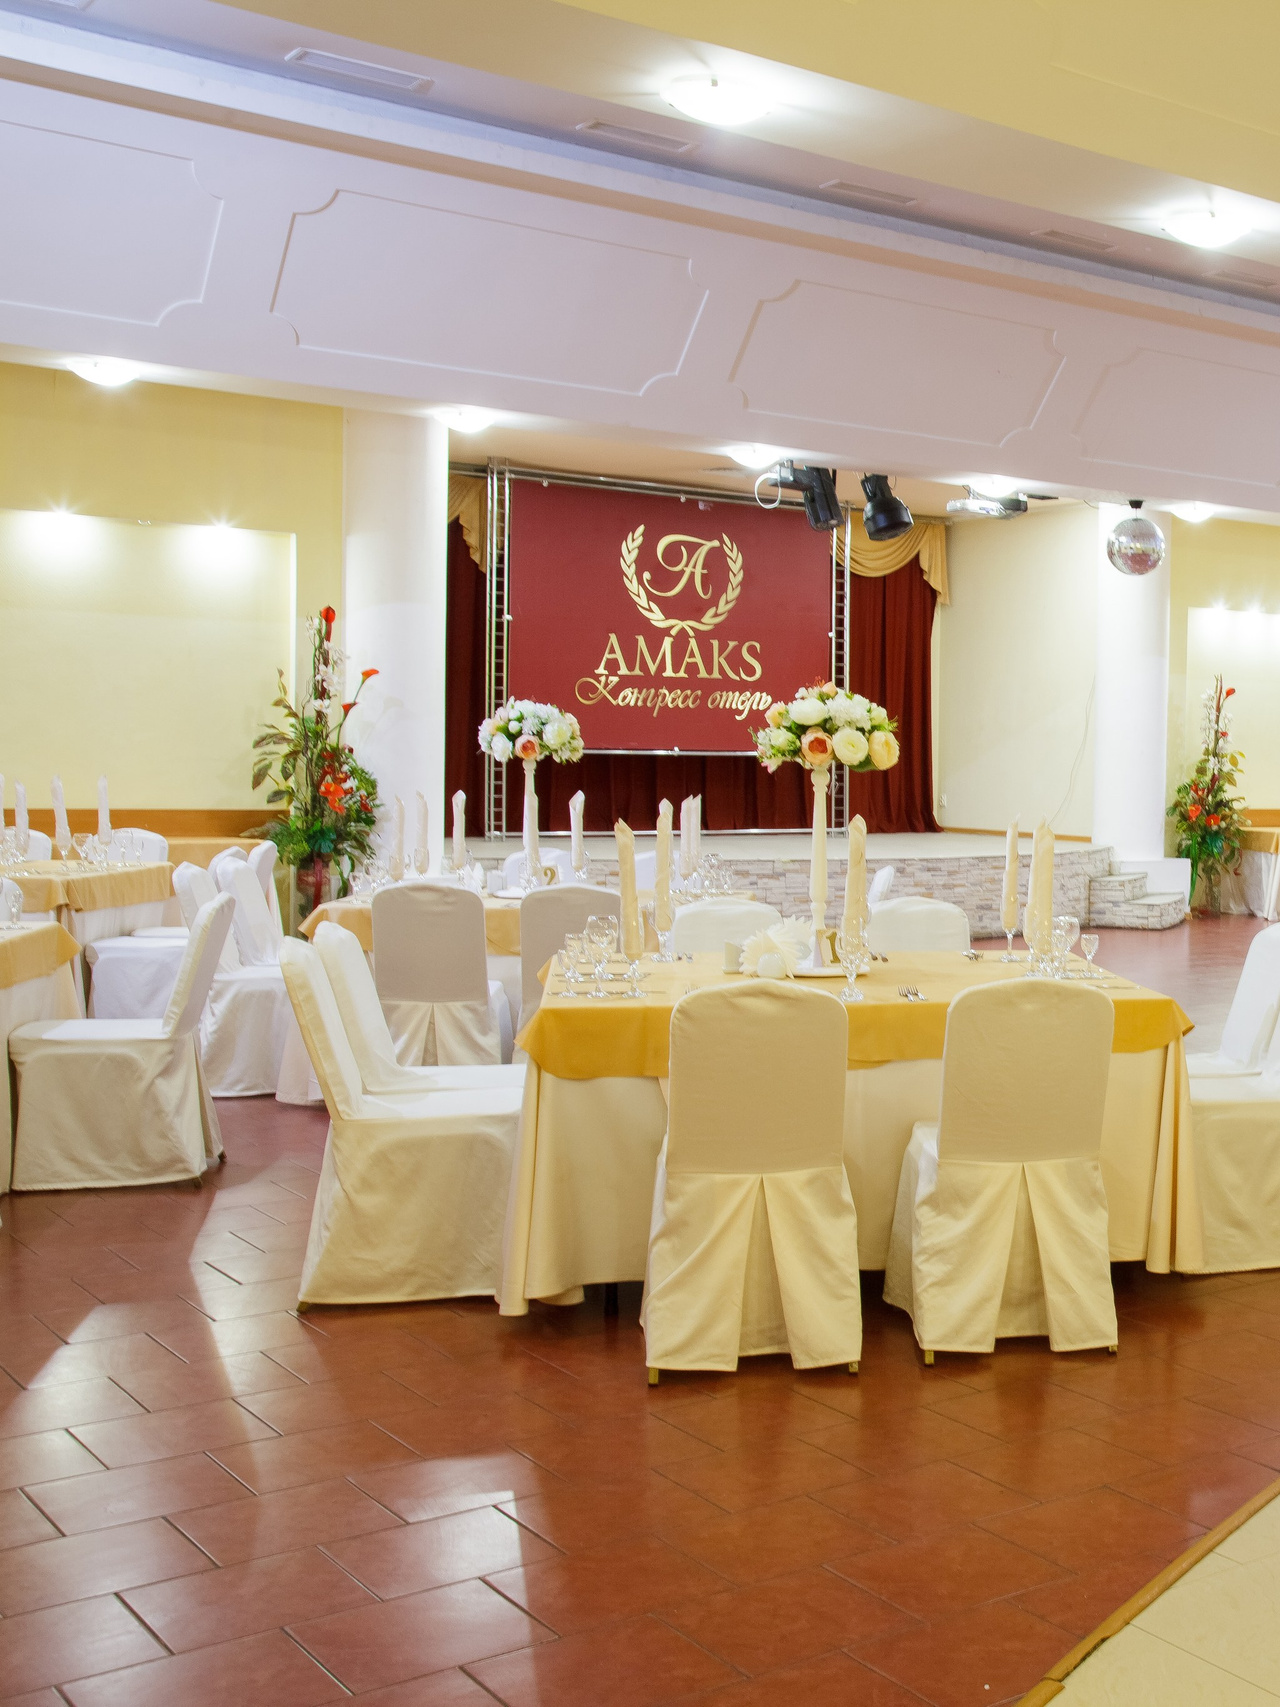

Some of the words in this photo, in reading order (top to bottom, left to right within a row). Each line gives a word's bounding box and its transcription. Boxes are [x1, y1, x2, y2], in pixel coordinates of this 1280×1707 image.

[594, 632, 763, 682] AMAKS
[575, 675, 702, 718] Конгресс
[707, 691, 773, 721] отель
[825, 931, 841, 964] 1
